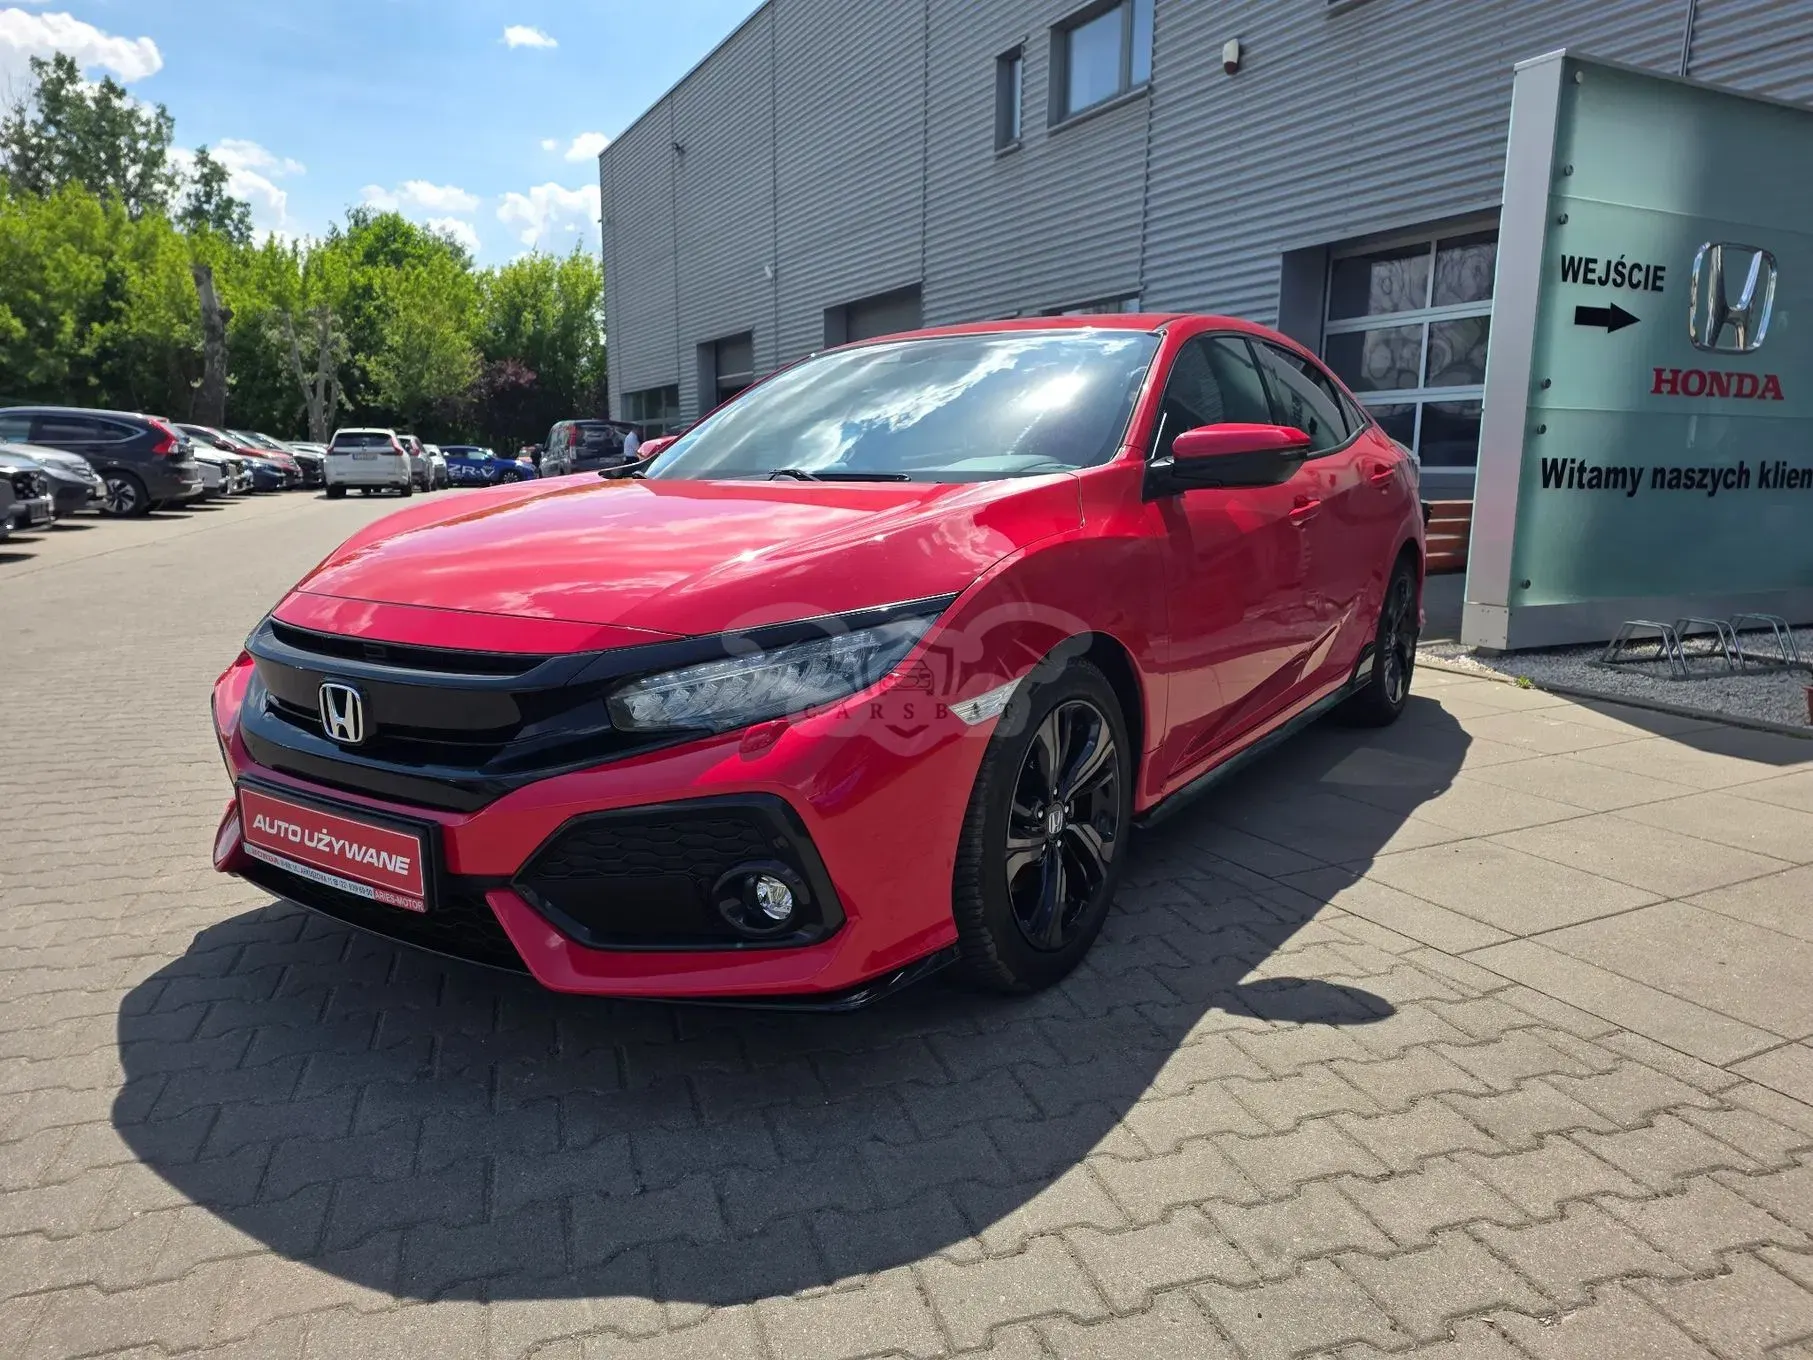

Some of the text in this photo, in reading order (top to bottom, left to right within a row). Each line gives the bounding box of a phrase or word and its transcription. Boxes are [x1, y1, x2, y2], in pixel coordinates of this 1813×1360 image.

[1560, 254, 1666, 292] WEJŚCIE
[1651, 367, 1784, 401] HONDA
[448, 463, 496, 478] ZR-V
[1541, 457, 1813, 498] Witamy naszych klien
[252, 814, 411, 876] AUTO UŻYWANE
[374, 889, 425, 912] ARIES-MOTOR
